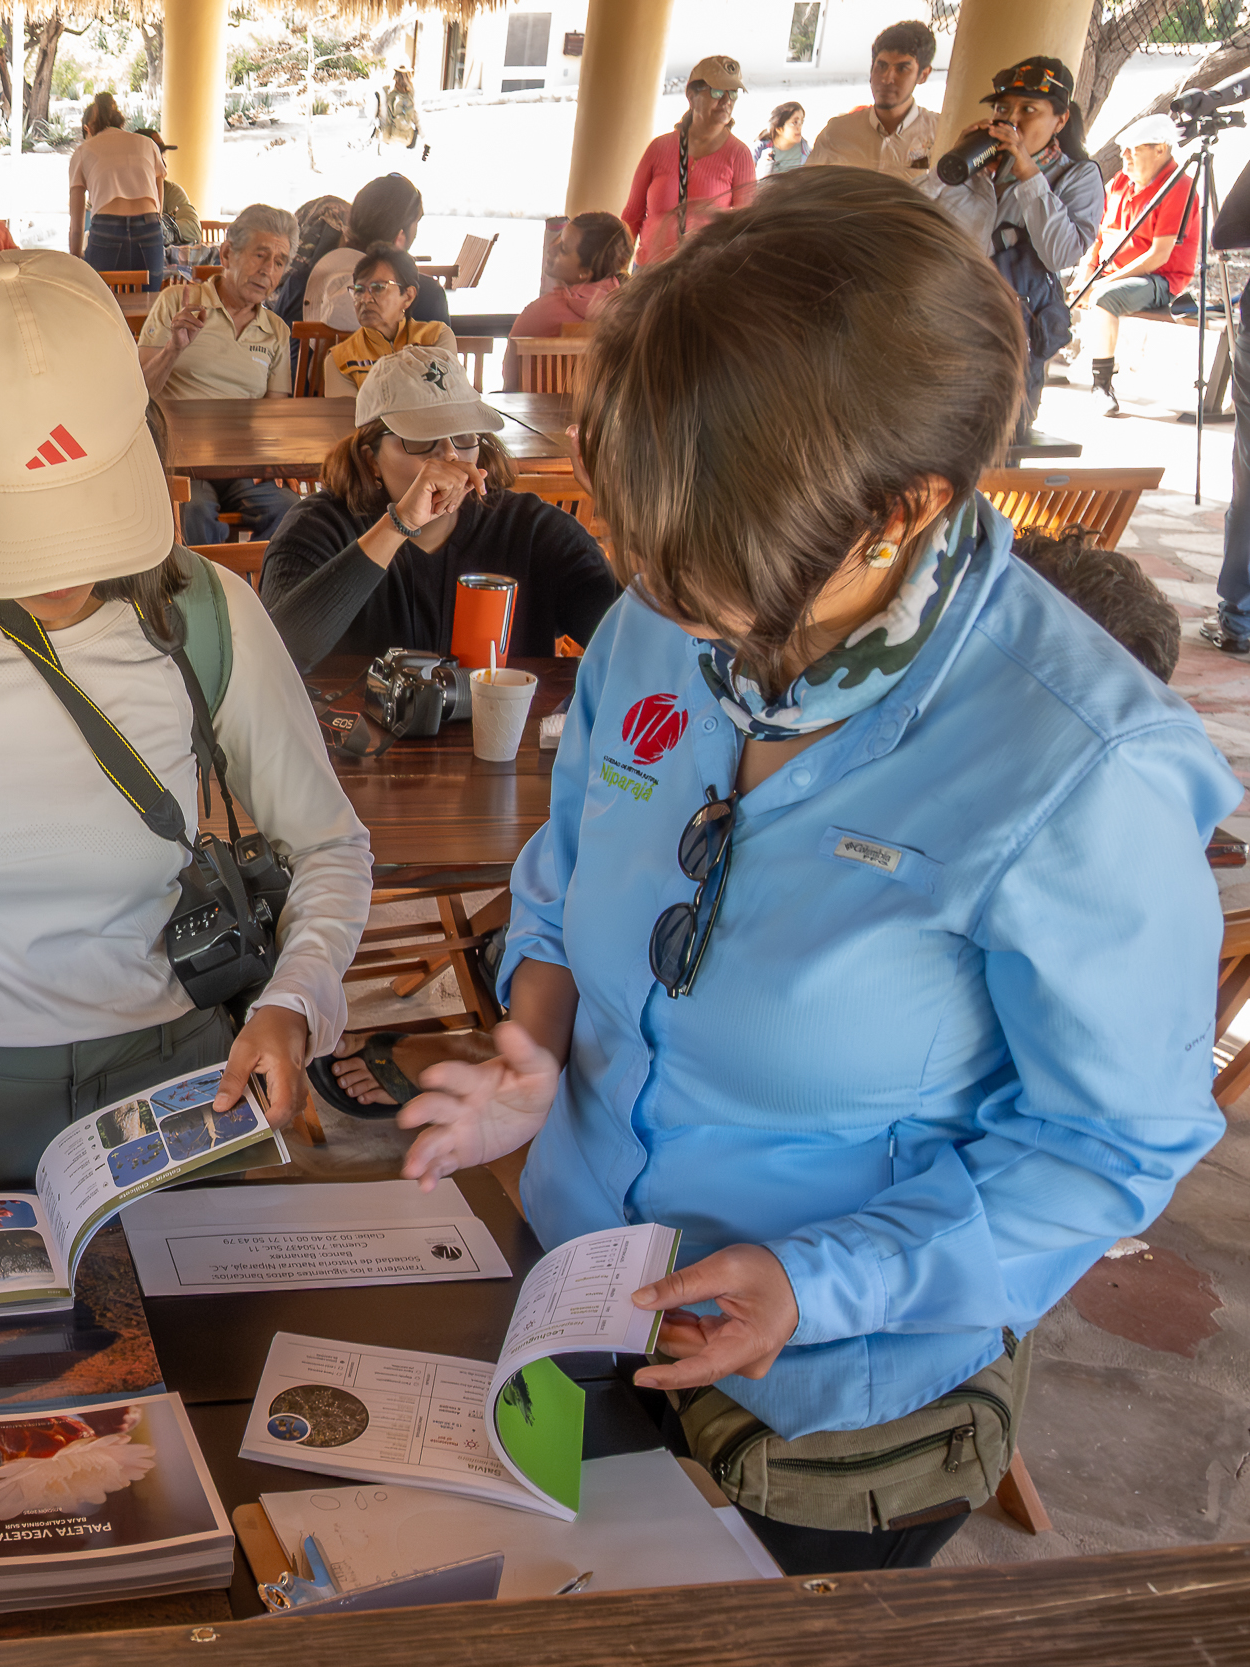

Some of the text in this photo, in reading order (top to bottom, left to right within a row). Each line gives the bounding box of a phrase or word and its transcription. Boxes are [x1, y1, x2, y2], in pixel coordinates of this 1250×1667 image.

[332, 717, 354, 730] EOS
[599, 761, 656, 802] Niparajá
[854, 843, 891, 862] Columbia
[354, 1232, 385, 1240] Clabe:
[261, 1244, 283, 1252] Suc.
[286, 1243, 327, 1251] 7150437
[329, 1241, 368, 1249] Cuenta:
[269, 1252, 316, 1260] Banamex
[375, 1256, 421, 1265] Sociedad
[230, 1261, 276, 1271] Niparajá,
[278, 1261, 316, 1269] Natural
[318, 1259, 358, 1268] Historia
[297, 1267, 349, 1277] siguientes
[376, 1264, 427, 1273] Transferir
[210, 1272, 264, 1280] bancarios:
[265, 1271, 295, 1279] datos
[467, 1463, 502, 1477] Salvia
[21, 1519, 66, 1528] CALIFORNIA
[55, 1522, 112, 1537] PALETA
